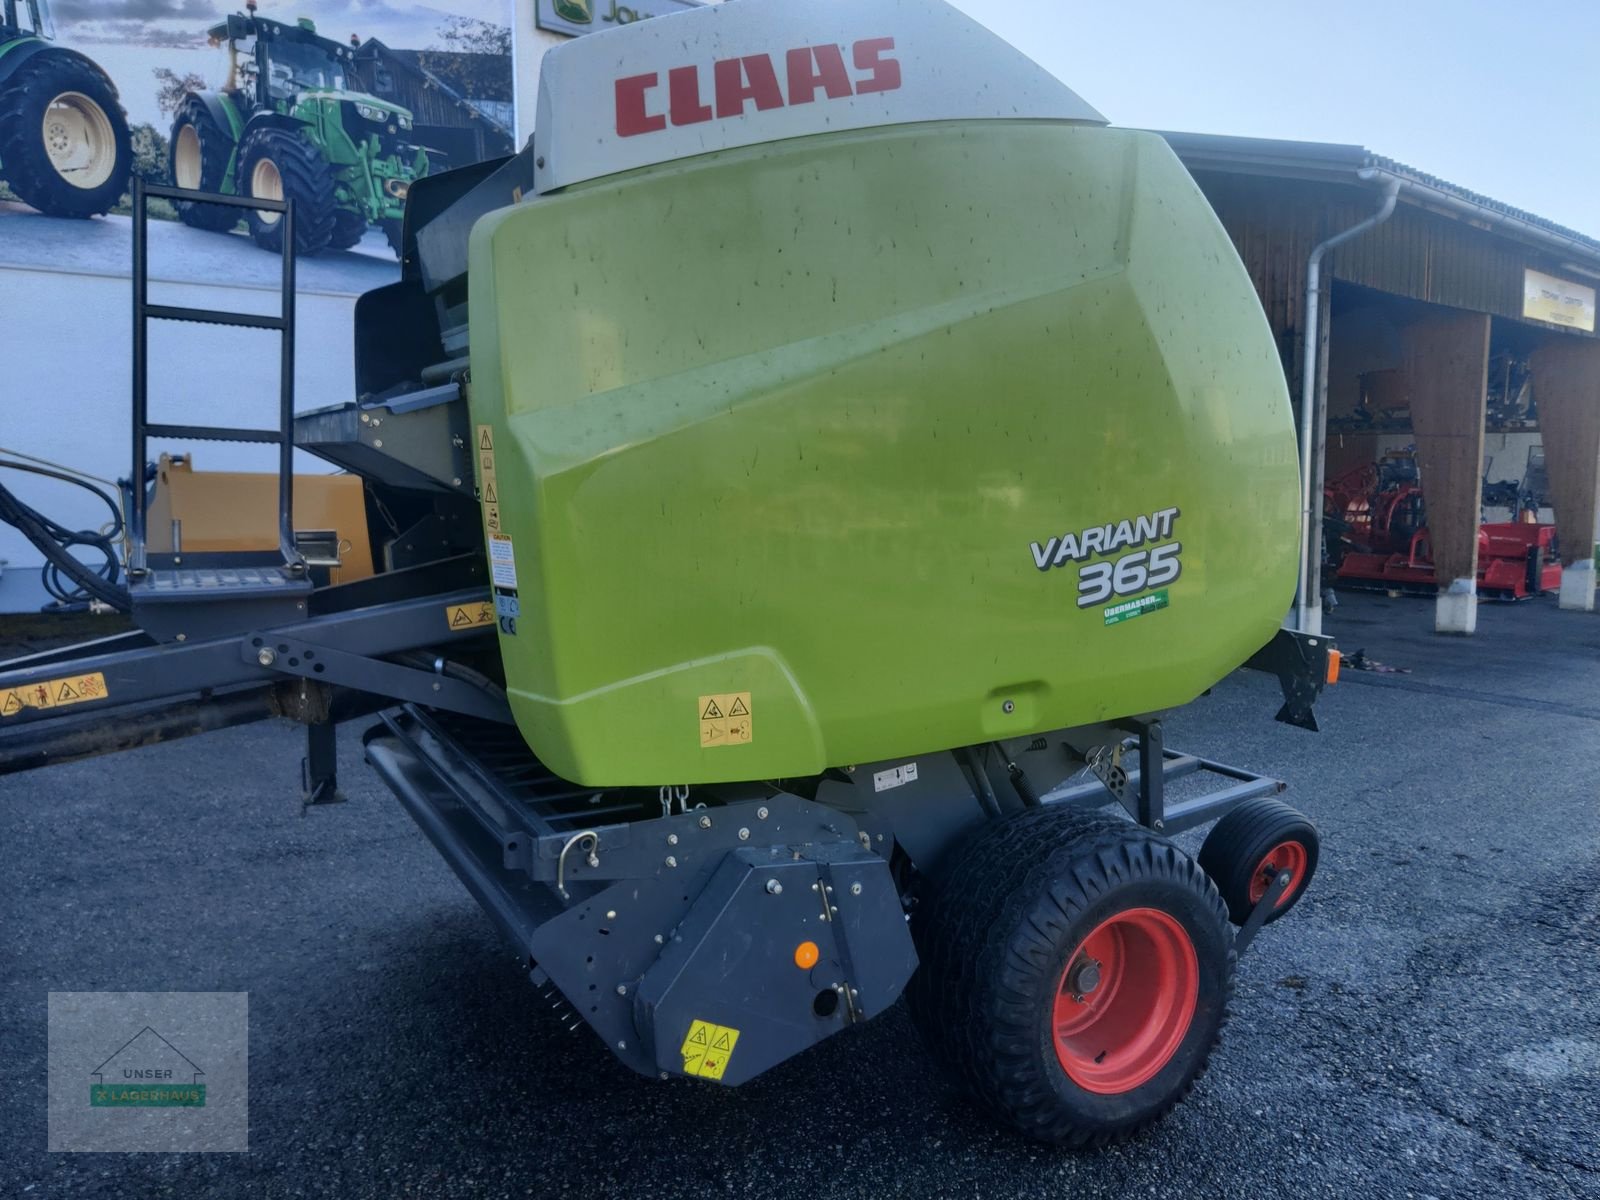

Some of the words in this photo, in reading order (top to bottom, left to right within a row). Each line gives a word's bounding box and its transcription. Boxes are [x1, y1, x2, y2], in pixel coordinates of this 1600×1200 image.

[614, 37, 902, 138] CLAAS
[1029, 506, 1181, 571] VARIANT
[1077, 541, 1182, 609] 365
